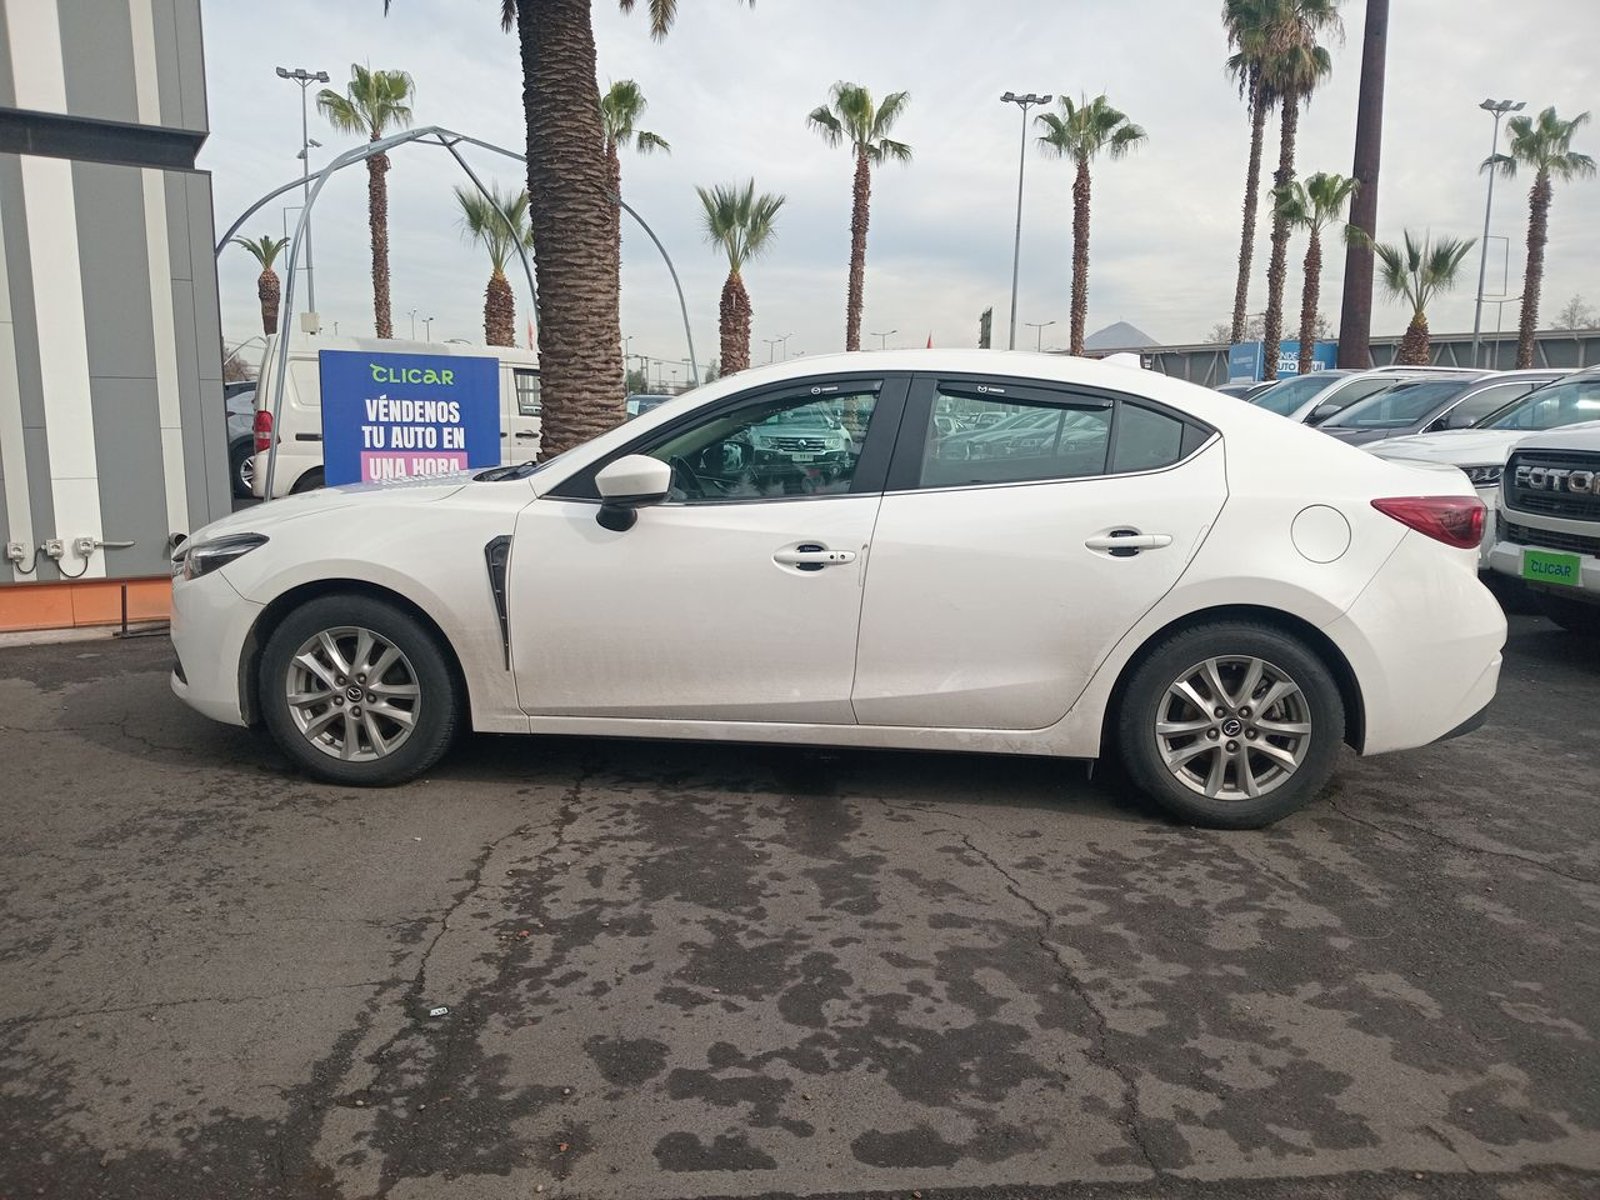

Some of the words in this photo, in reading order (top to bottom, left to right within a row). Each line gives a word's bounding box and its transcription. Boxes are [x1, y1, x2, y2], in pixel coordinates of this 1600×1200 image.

[365, 394, 461, 424] VÉNDENOS
[361, 425, 385, 448] TU
[391, 426, 437, 449] AUTO
[443, 427, 465, 449] EN
[369, 457, 407, 480] UNA
[413, 458, 460, 476] HORA
